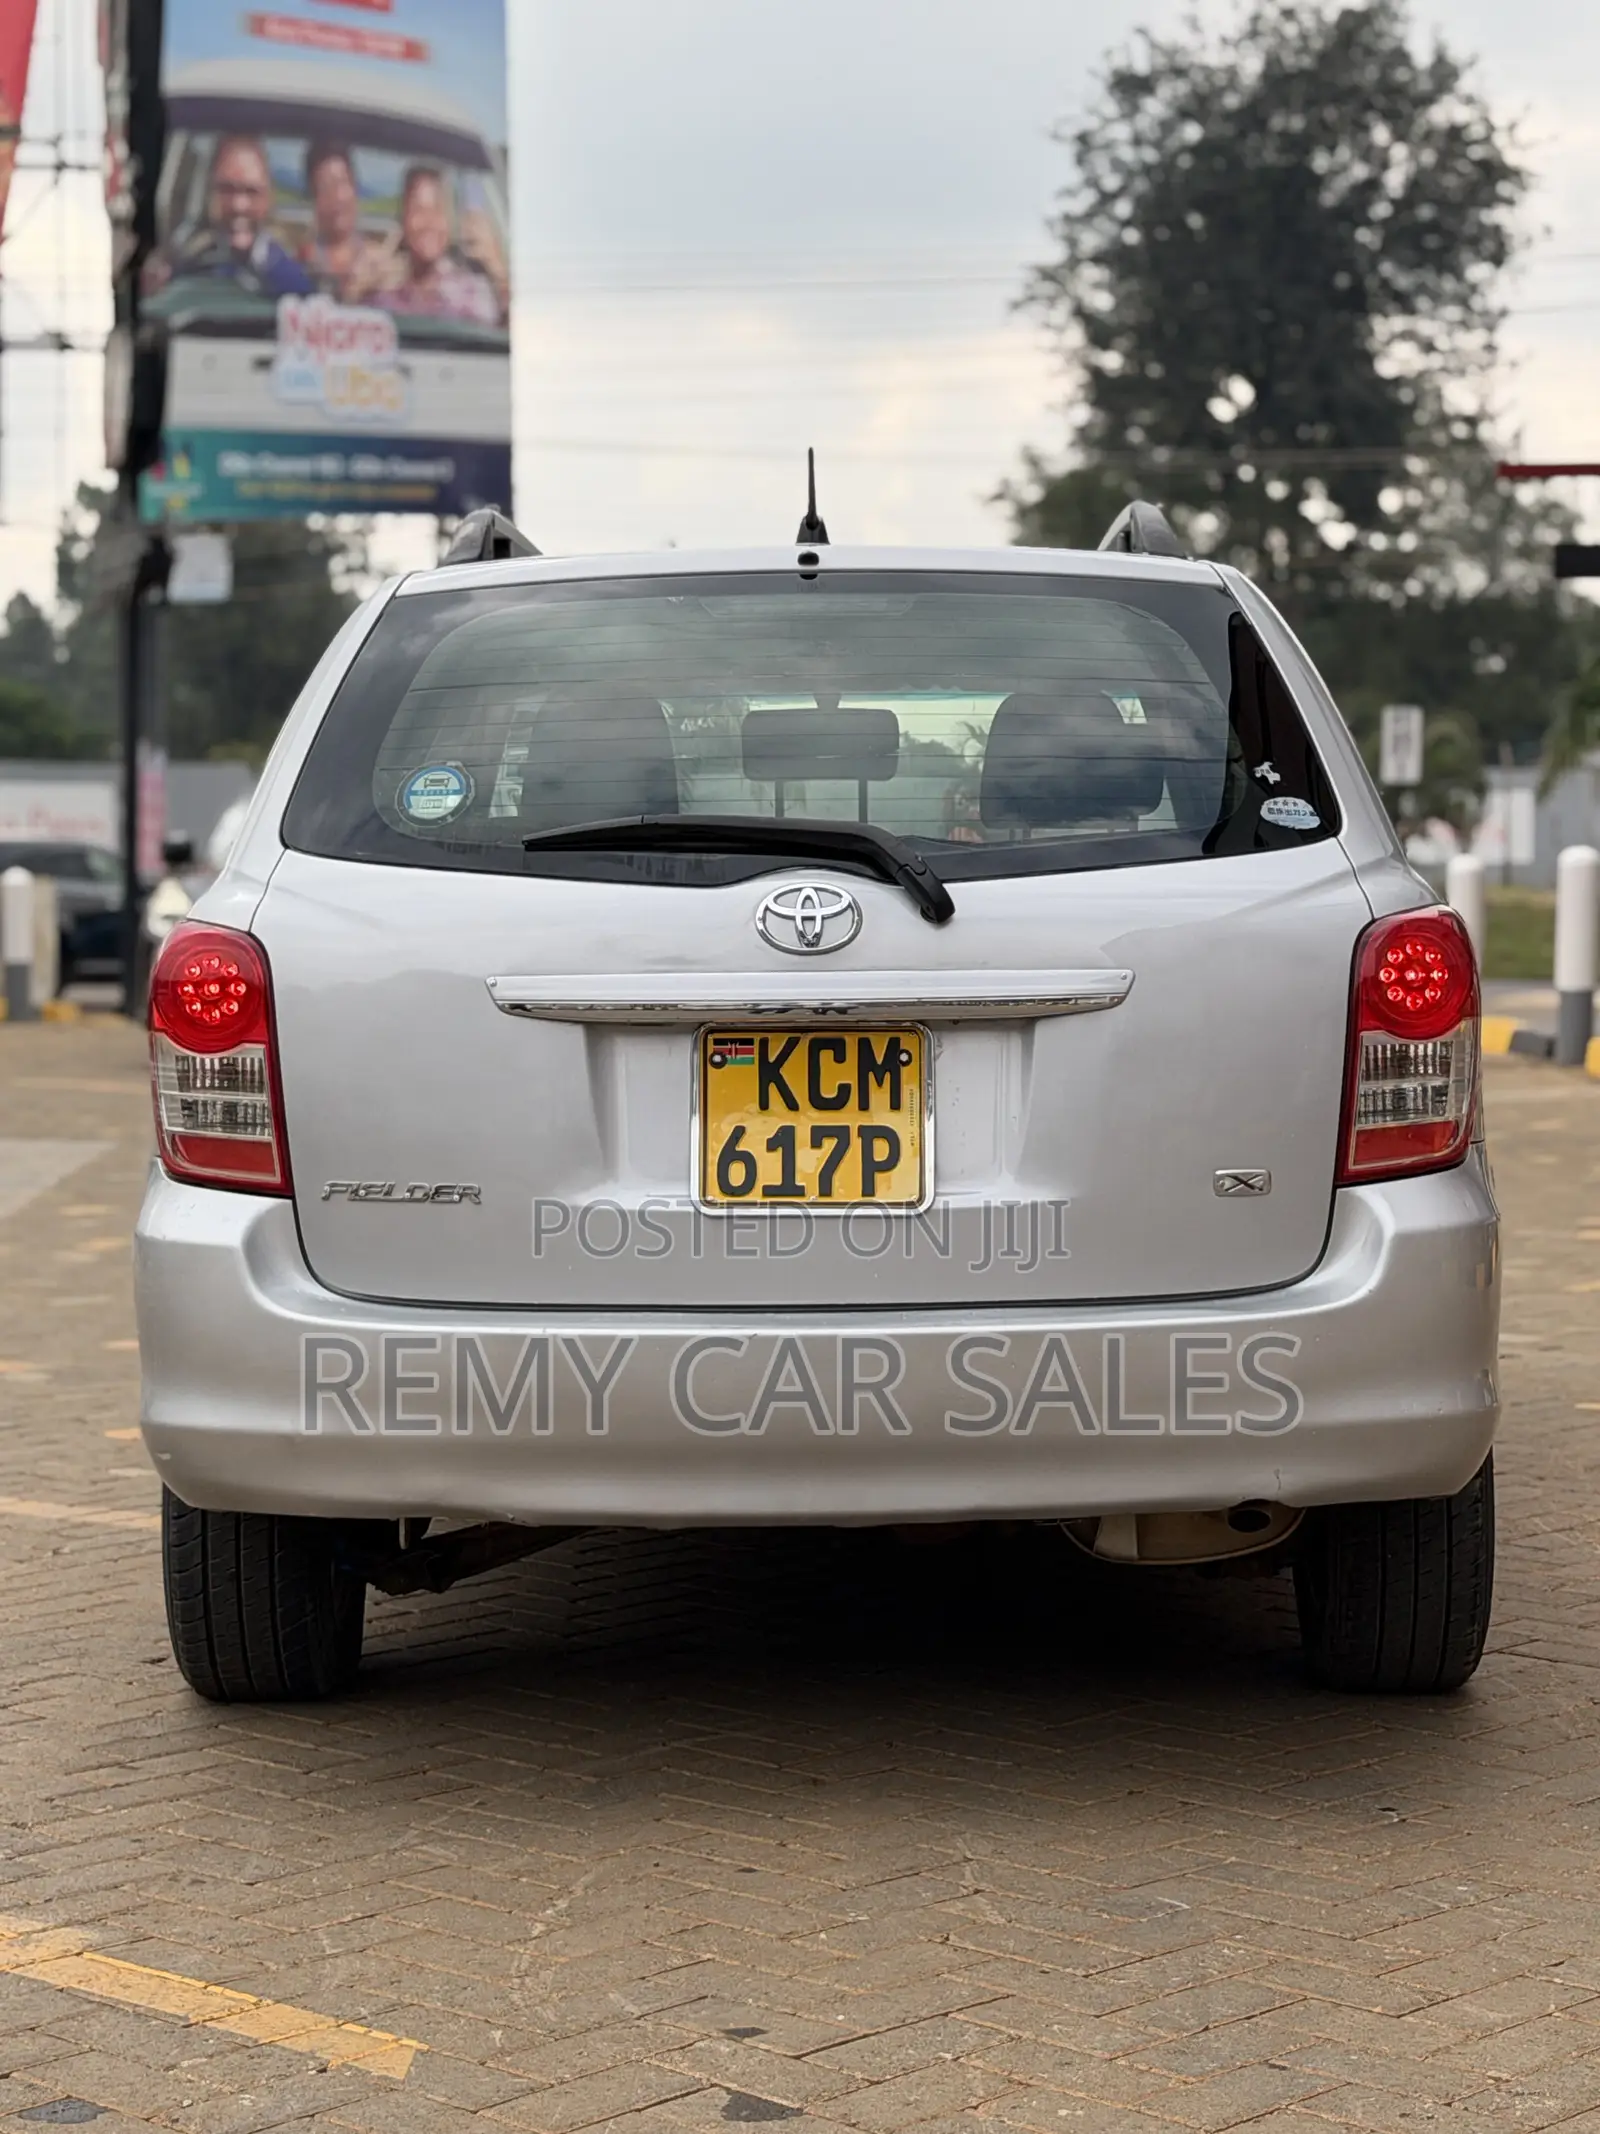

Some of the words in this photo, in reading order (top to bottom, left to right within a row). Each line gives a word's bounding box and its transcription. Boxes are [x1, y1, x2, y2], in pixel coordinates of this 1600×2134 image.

[758, 1036, 901, 1111] KCM
[321, 1180, 482, 1205] FIELDER
[716, 1125, 901, 1197] 617P
